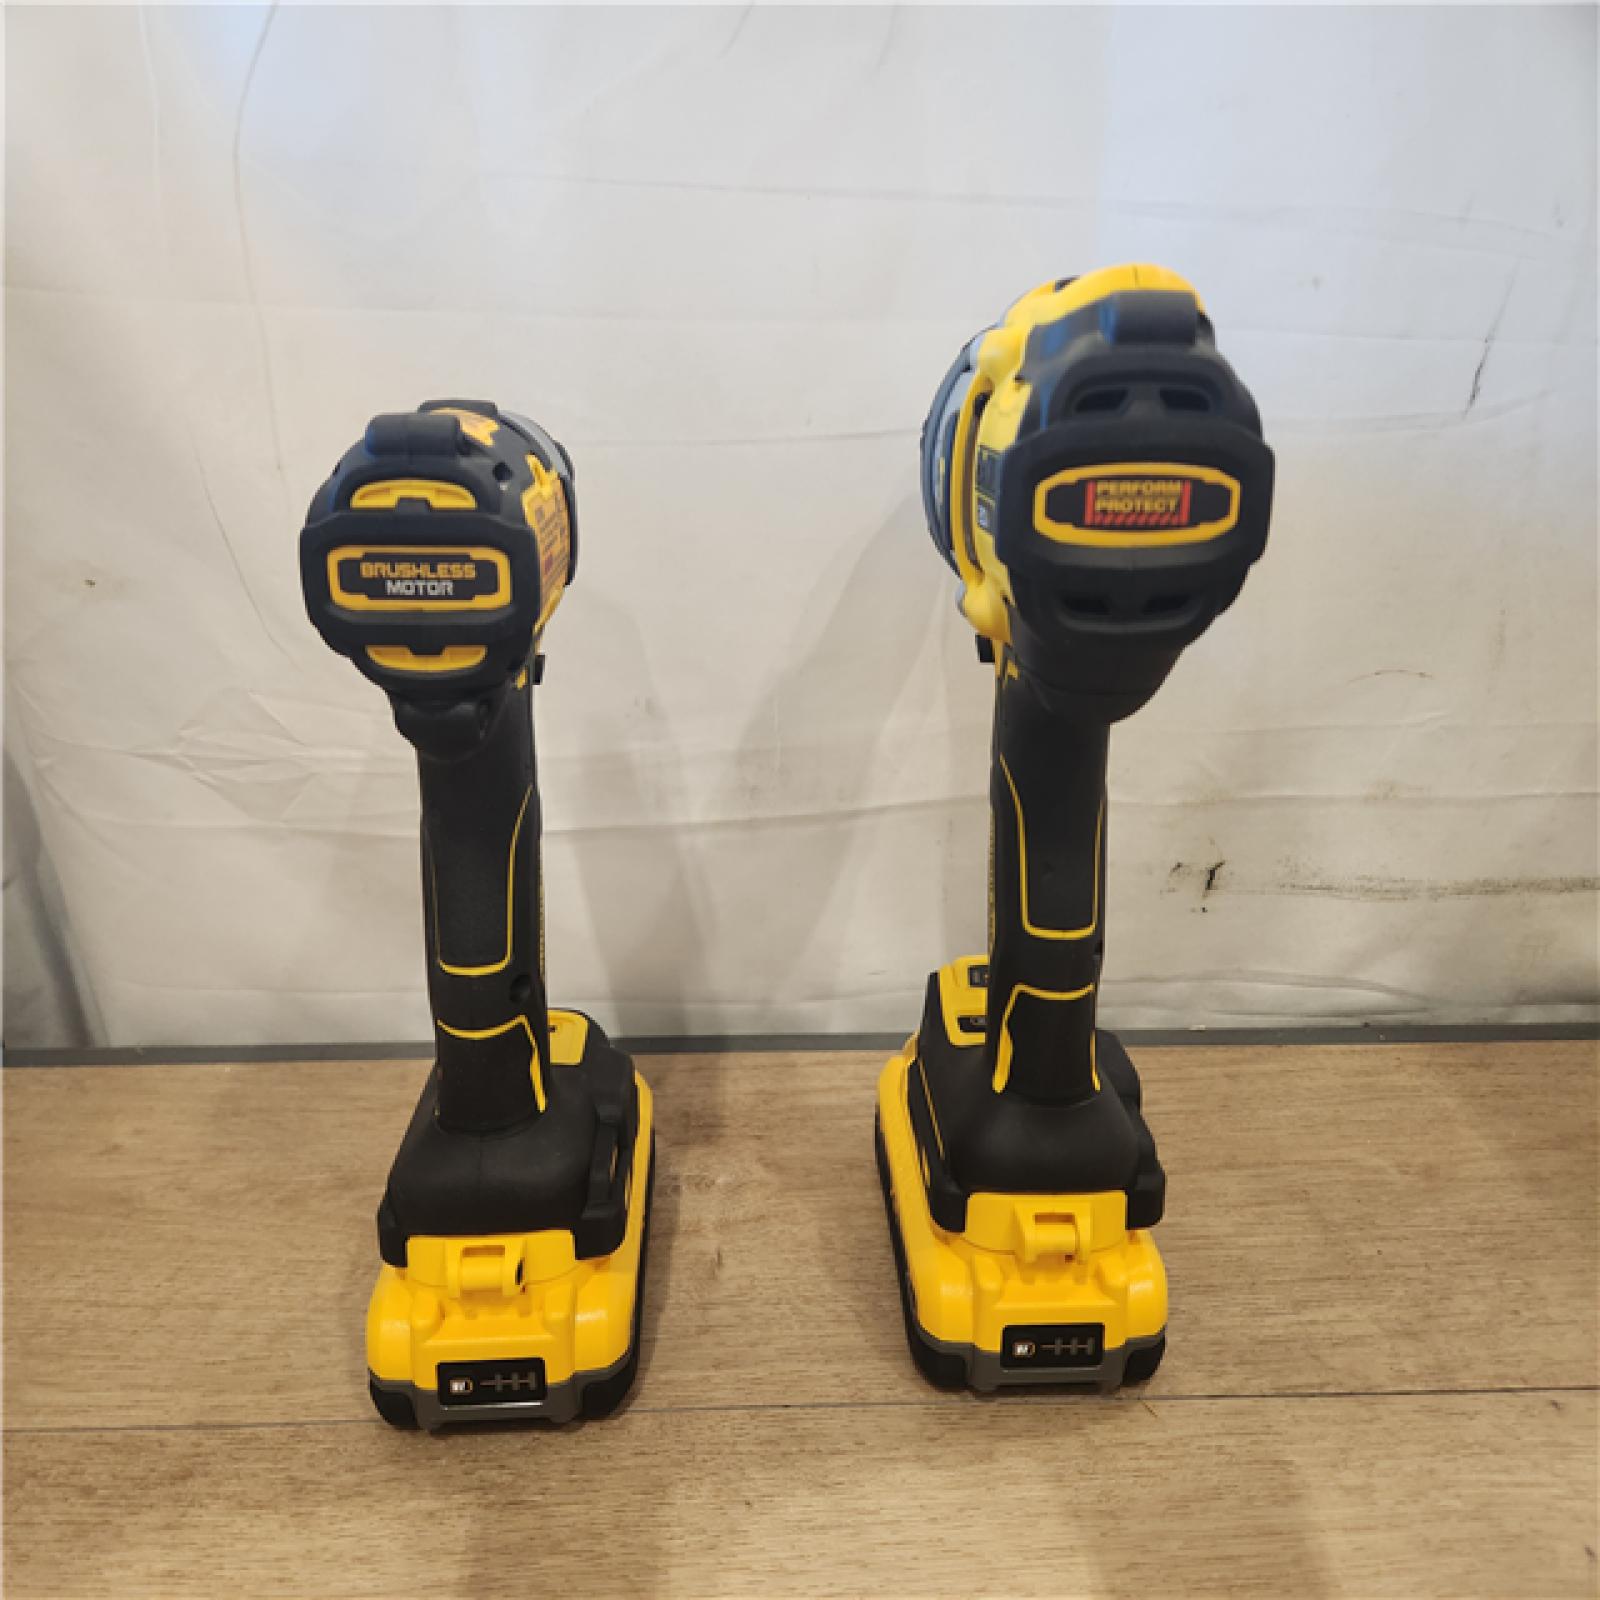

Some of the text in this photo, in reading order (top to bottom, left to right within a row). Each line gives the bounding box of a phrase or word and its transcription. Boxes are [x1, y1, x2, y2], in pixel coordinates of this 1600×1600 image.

[1096, 481, 1181, 496] PERFORM
[1095, 497, 1178, 513] PROTECT
[361, 562, 476, 578] BRUSHLESS
[385, 579, 453, 596] MOTOR
